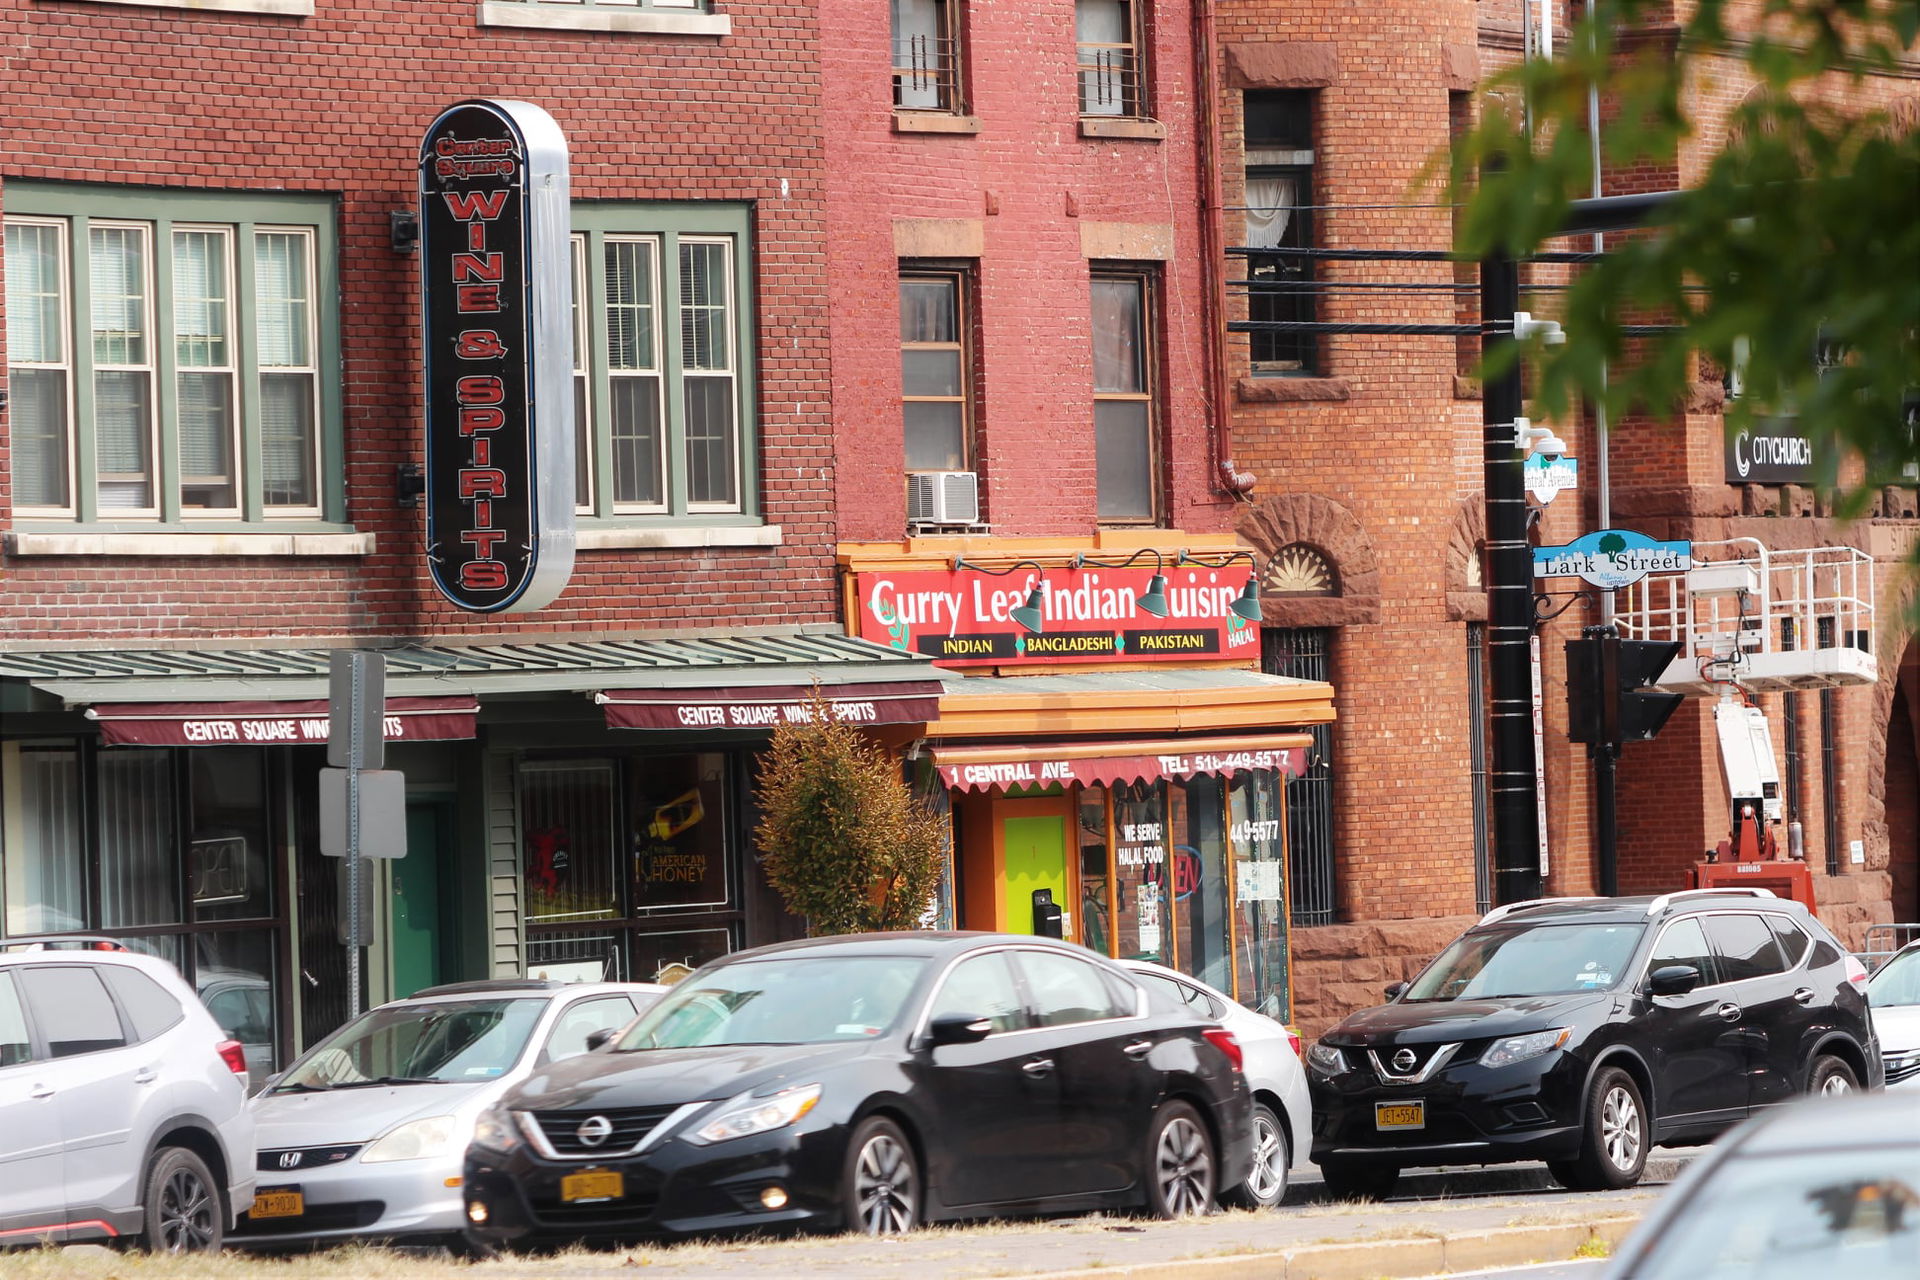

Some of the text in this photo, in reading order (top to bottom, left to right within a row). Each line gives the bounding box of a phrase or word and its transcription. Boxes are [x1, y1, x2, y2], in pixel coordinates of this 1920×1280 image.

[435, 137, 514, 158] Center
[434, 158, 516, 180] Square
[442, 190, 510, 314] WINE
[456, 375, 509, 591] SPIRITS
[1524, 471, 1576, 488] ntral Avenue
[1543, 553, 1682, 575] Lark Street
[871, 580, 962, 638] Curry
[1042, 573, 1136, 621] Indian
[943, 639, 993, 654] INDIAN
[1027, 635, 1113, 652] BANGLADESHI
[1139, 634, 1204, 649] PAKISTANI
[1227, 626, 1256, 649] HALAL
[677, 706, 725, 725] CENTER
[730, 705, 779, 724] SQUARE
[782, 704, 814, 723] WINE
[832, 702, 877, 722] SPIRITS
[182, 720, 239, 741] CENTER
[241, 719, 298, 741] SQUARE
[950, 761, 1075, 783] 1 CENTRAL AVE.
[1158, 755, 1189, 774] TEL:
[1123, 823, 1161, 842] WE SERVE
[1230, 820, 1279, 843] 449-5577
[652, 854, 706, 867] AMERICAN
[1118, 846, 1164, 866] HALAL FOOD
[652, 866, 707, 883] HONEY
